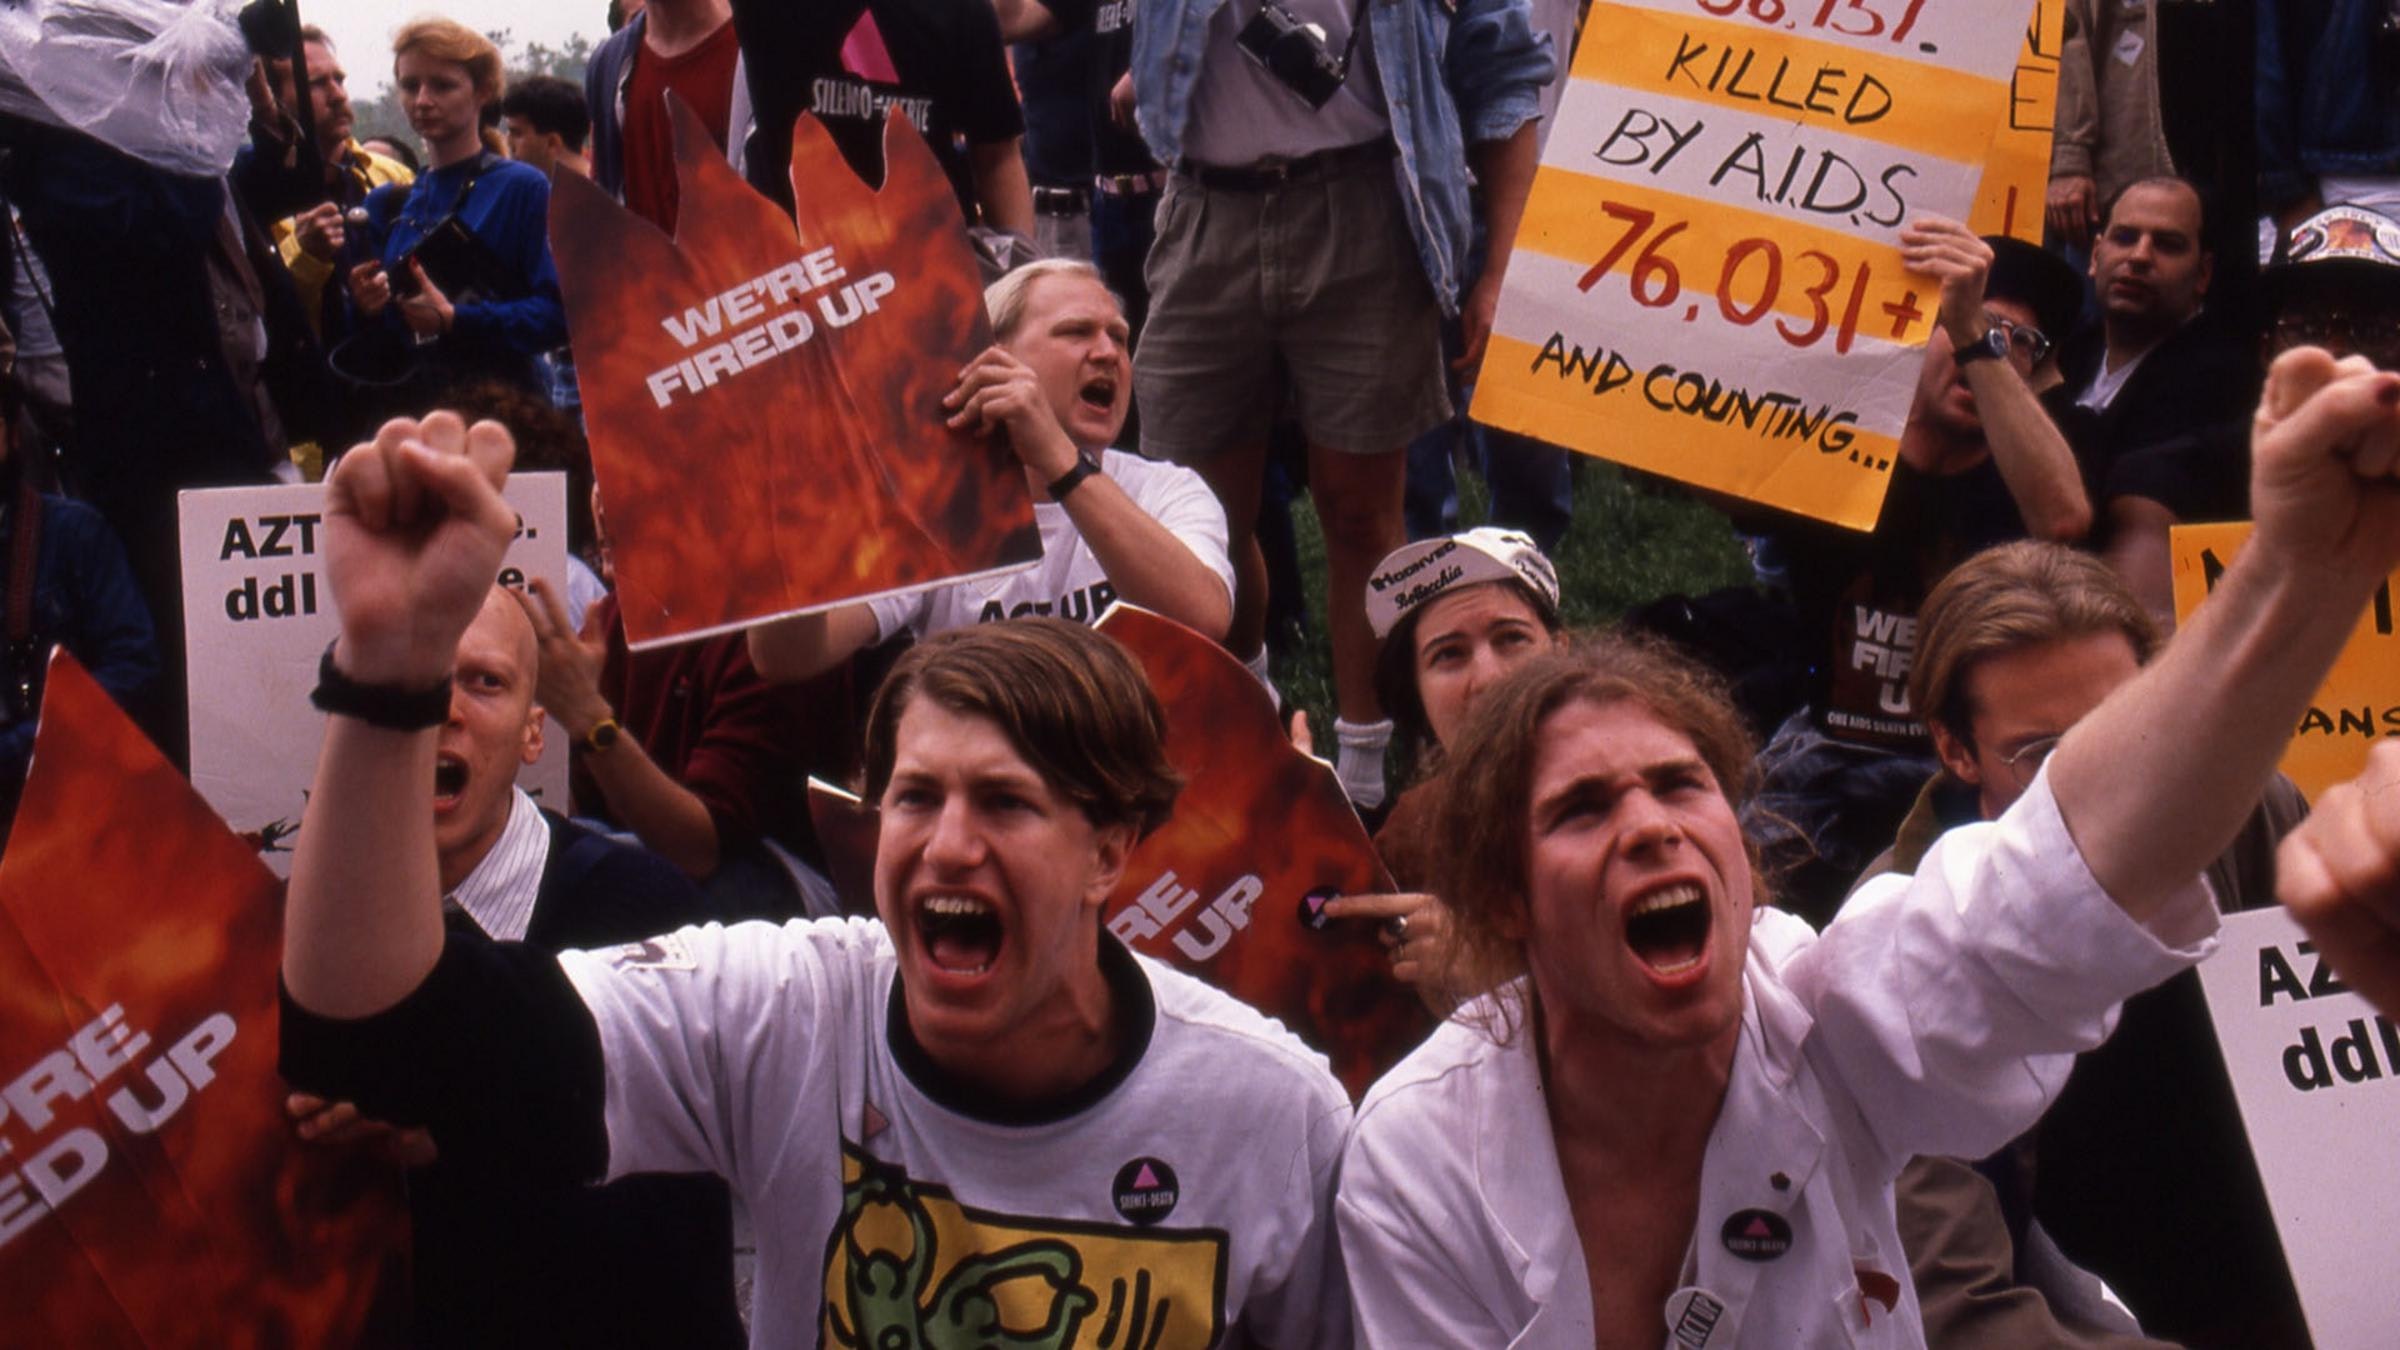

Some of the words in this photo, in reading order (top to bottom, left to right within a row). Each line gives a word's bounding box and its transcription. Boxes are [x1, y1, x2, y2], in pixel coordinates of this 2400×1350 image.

[1666, 32, 1893, 125] KILLED
[1593, 109, 1704, 174] BY
[646, 309, 815, 409] FIRED
[816, 271, 896, 328] UP
[660, 245, 848, 348] WE'RE
[220, 513, 322, 561] AZT
[1172, 873, 1264, 962] UP
[107, 1012, 238, 1135] UP
